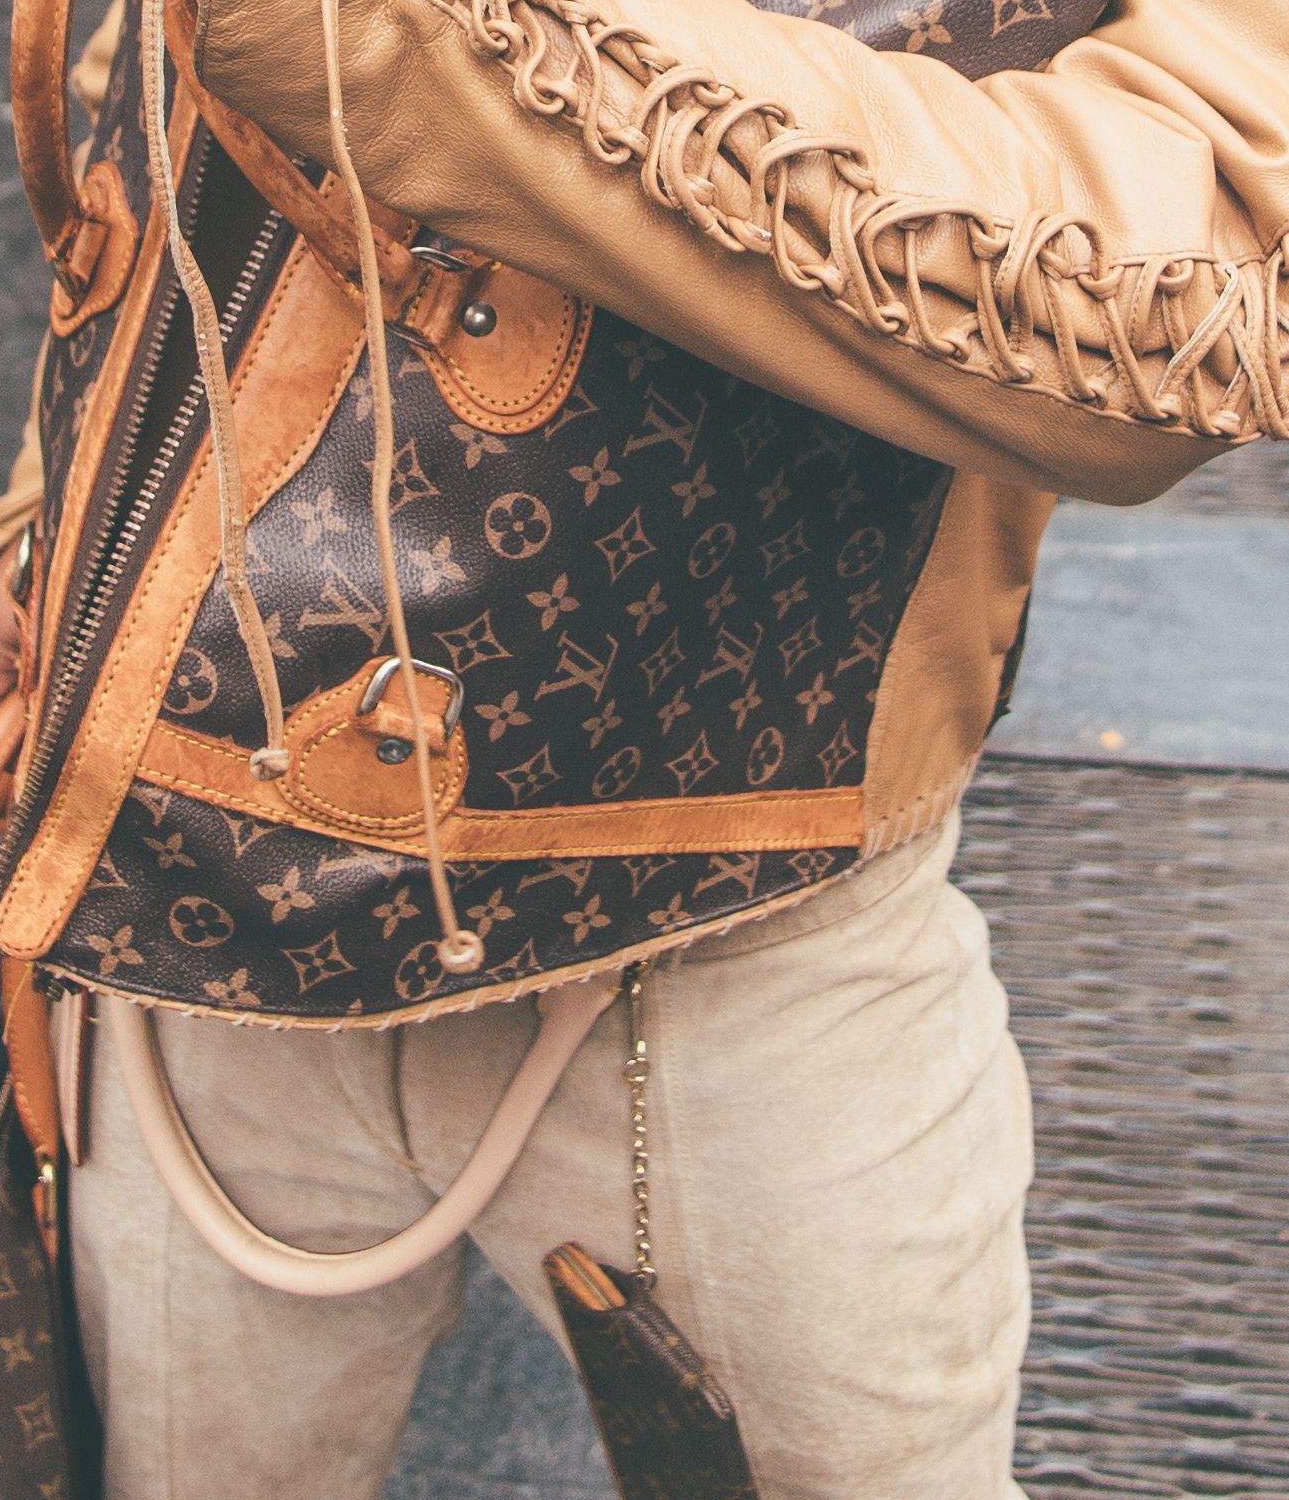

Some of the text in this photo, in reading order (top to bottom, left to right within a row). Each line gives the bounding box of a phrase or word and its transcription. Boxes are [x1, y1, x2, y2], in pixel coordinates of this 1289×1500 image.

[622, 382, 708, 465] LV
[534, 630, 619, 702] LV
[695, 621, 765, 691] LV
[832, 614, 894, 679] LV
